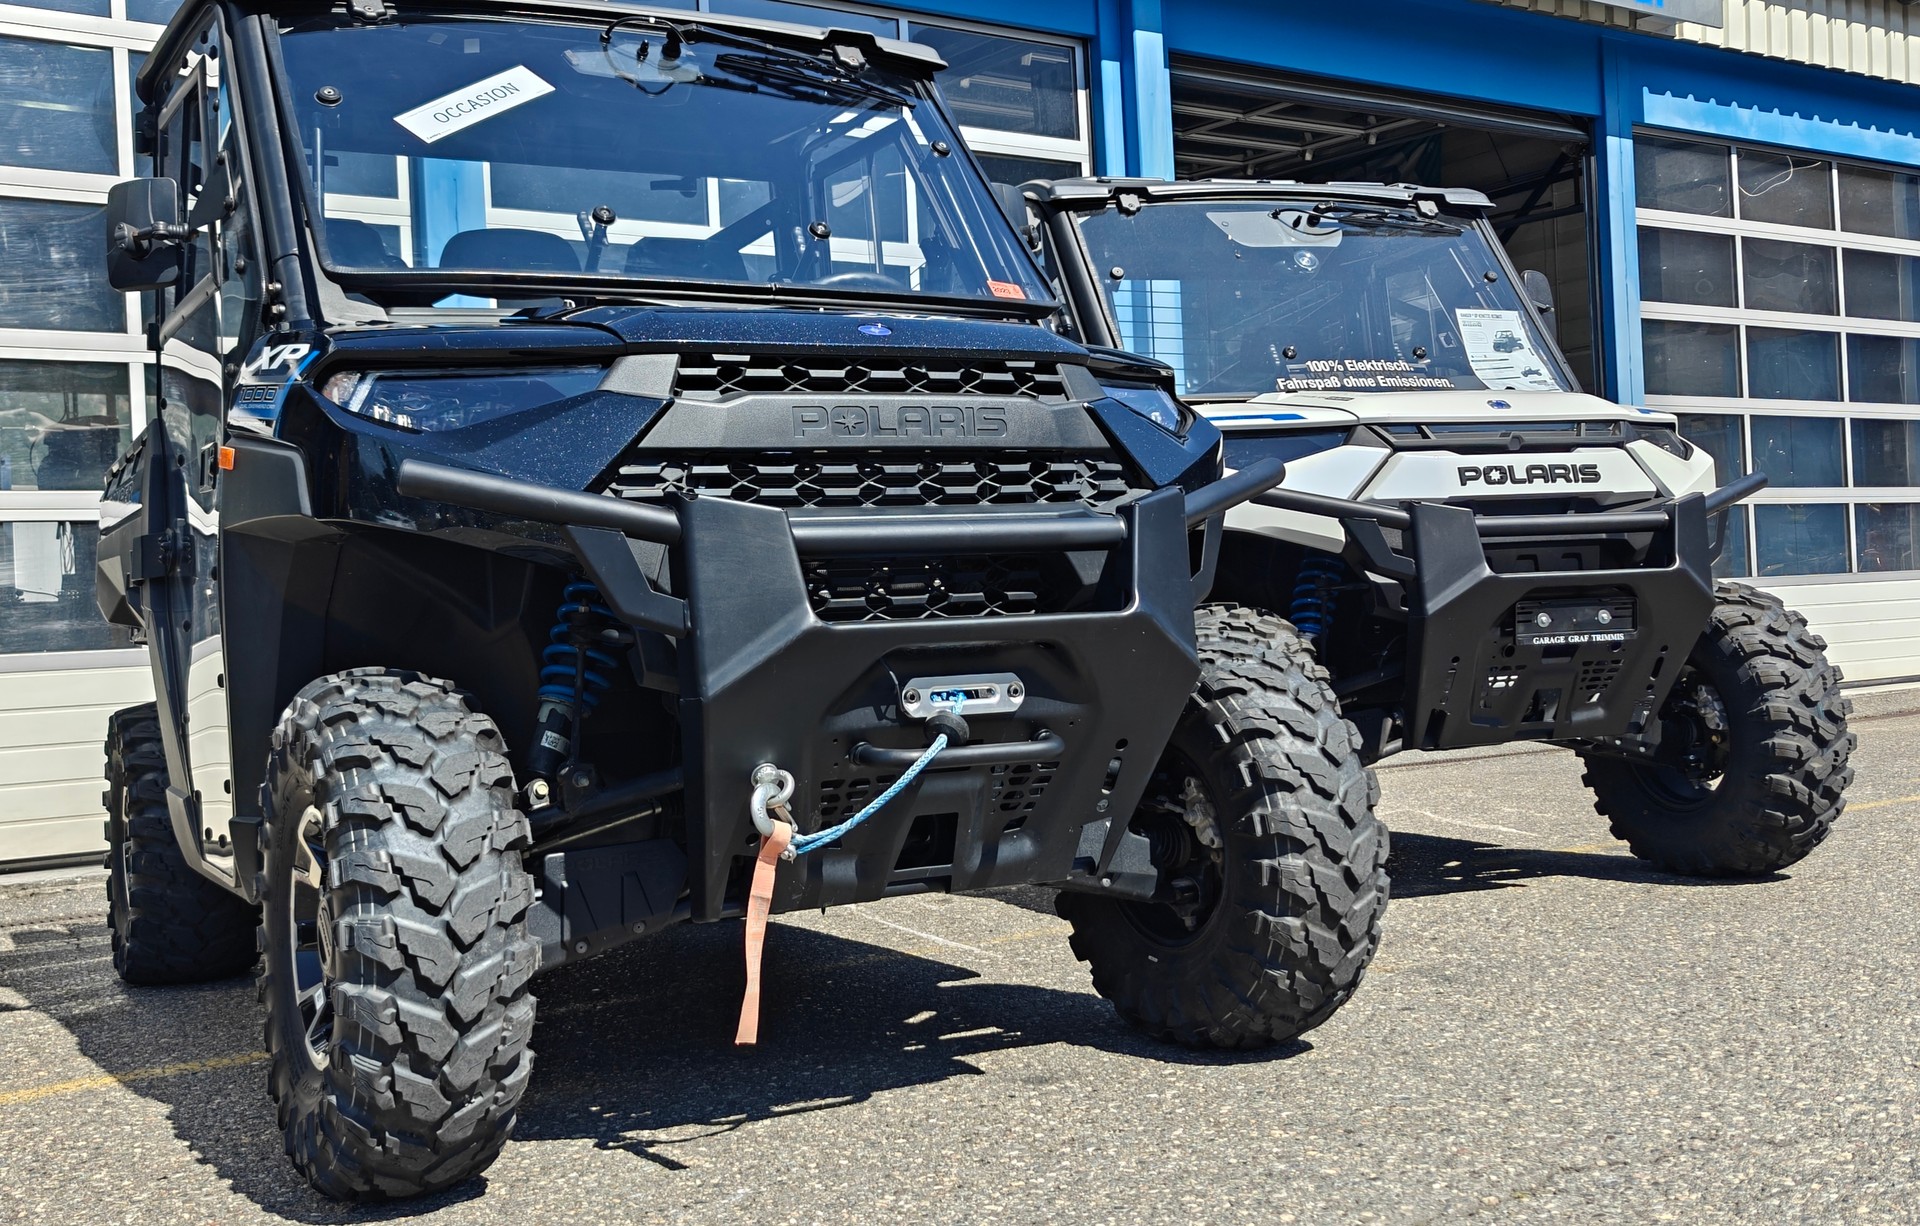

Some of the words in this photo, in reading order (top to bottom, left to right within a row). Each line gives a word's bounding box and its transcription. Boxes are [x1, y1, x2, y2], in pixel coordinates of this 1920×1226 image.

[433, 82, 520, 124] OCCASION
[248, 343, 311, 372] XP
[1306, 360, 1344, 372] 100%
[1346, 359, 1414, 372] Elektrisch.
[1277, 378, 1341, 390] Fahrspaß
[1343, 377, 1376, 388] ohne
[1379, 376, 1455, 388] Emissionen.
[239, 385, 280, 403] 1000
[792, 405, 1008, 438] POLARIS
[1457, 464, 1601, 486] POLARIS
[1533, 636, 1565, 645] GARAGE
[1568, 635, 1590, 643] GRAF
[1591, 633, 1625, 642] TRIMMIS
